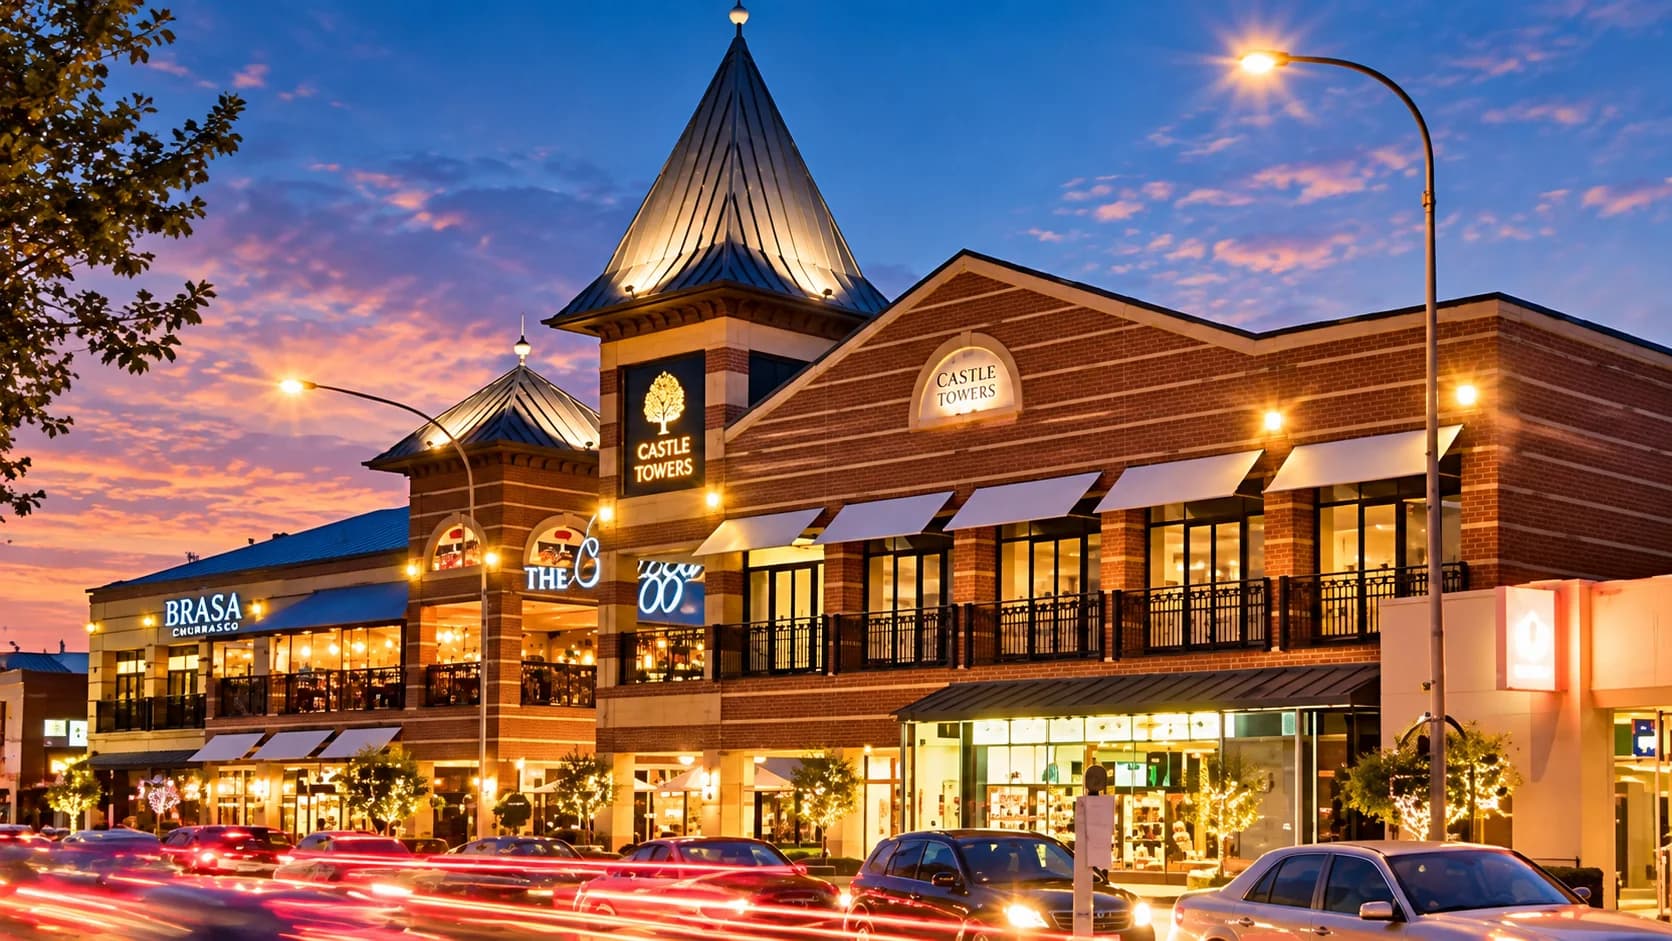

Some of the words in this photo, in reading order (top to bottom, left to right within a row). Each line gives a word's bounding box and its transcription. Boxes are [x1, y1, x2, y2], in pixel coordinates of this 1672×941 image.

[937, 365, 996, 388] CASTLE
[937, 384, 996, 407] TOWERS
[637, 436, 691, 461] CASTLE
[634, 458, 693, 483] TOWERS
[523, 566, 568, 590] THE
[165, 592, 242, 627] BRASA
